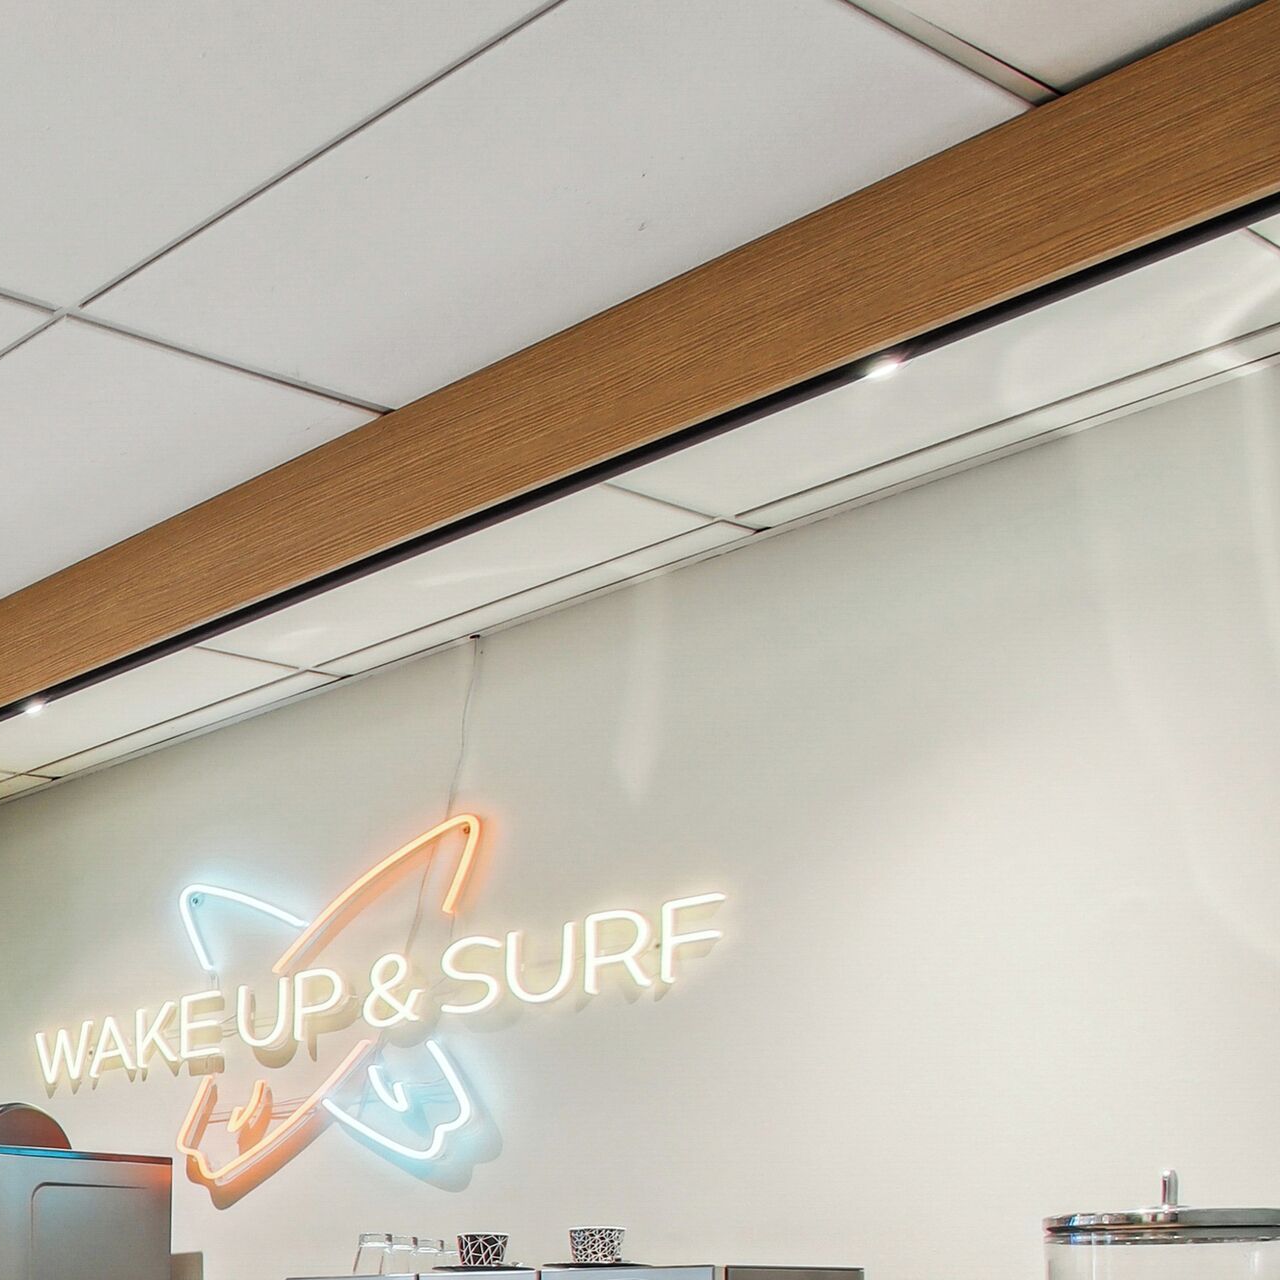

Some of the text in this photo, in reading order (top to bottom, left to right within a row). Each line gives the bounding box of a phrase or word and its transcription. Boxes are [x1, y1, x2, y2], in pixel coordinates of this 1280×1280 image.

[36, 892, 727, 1086] WAKE UP & SURF
